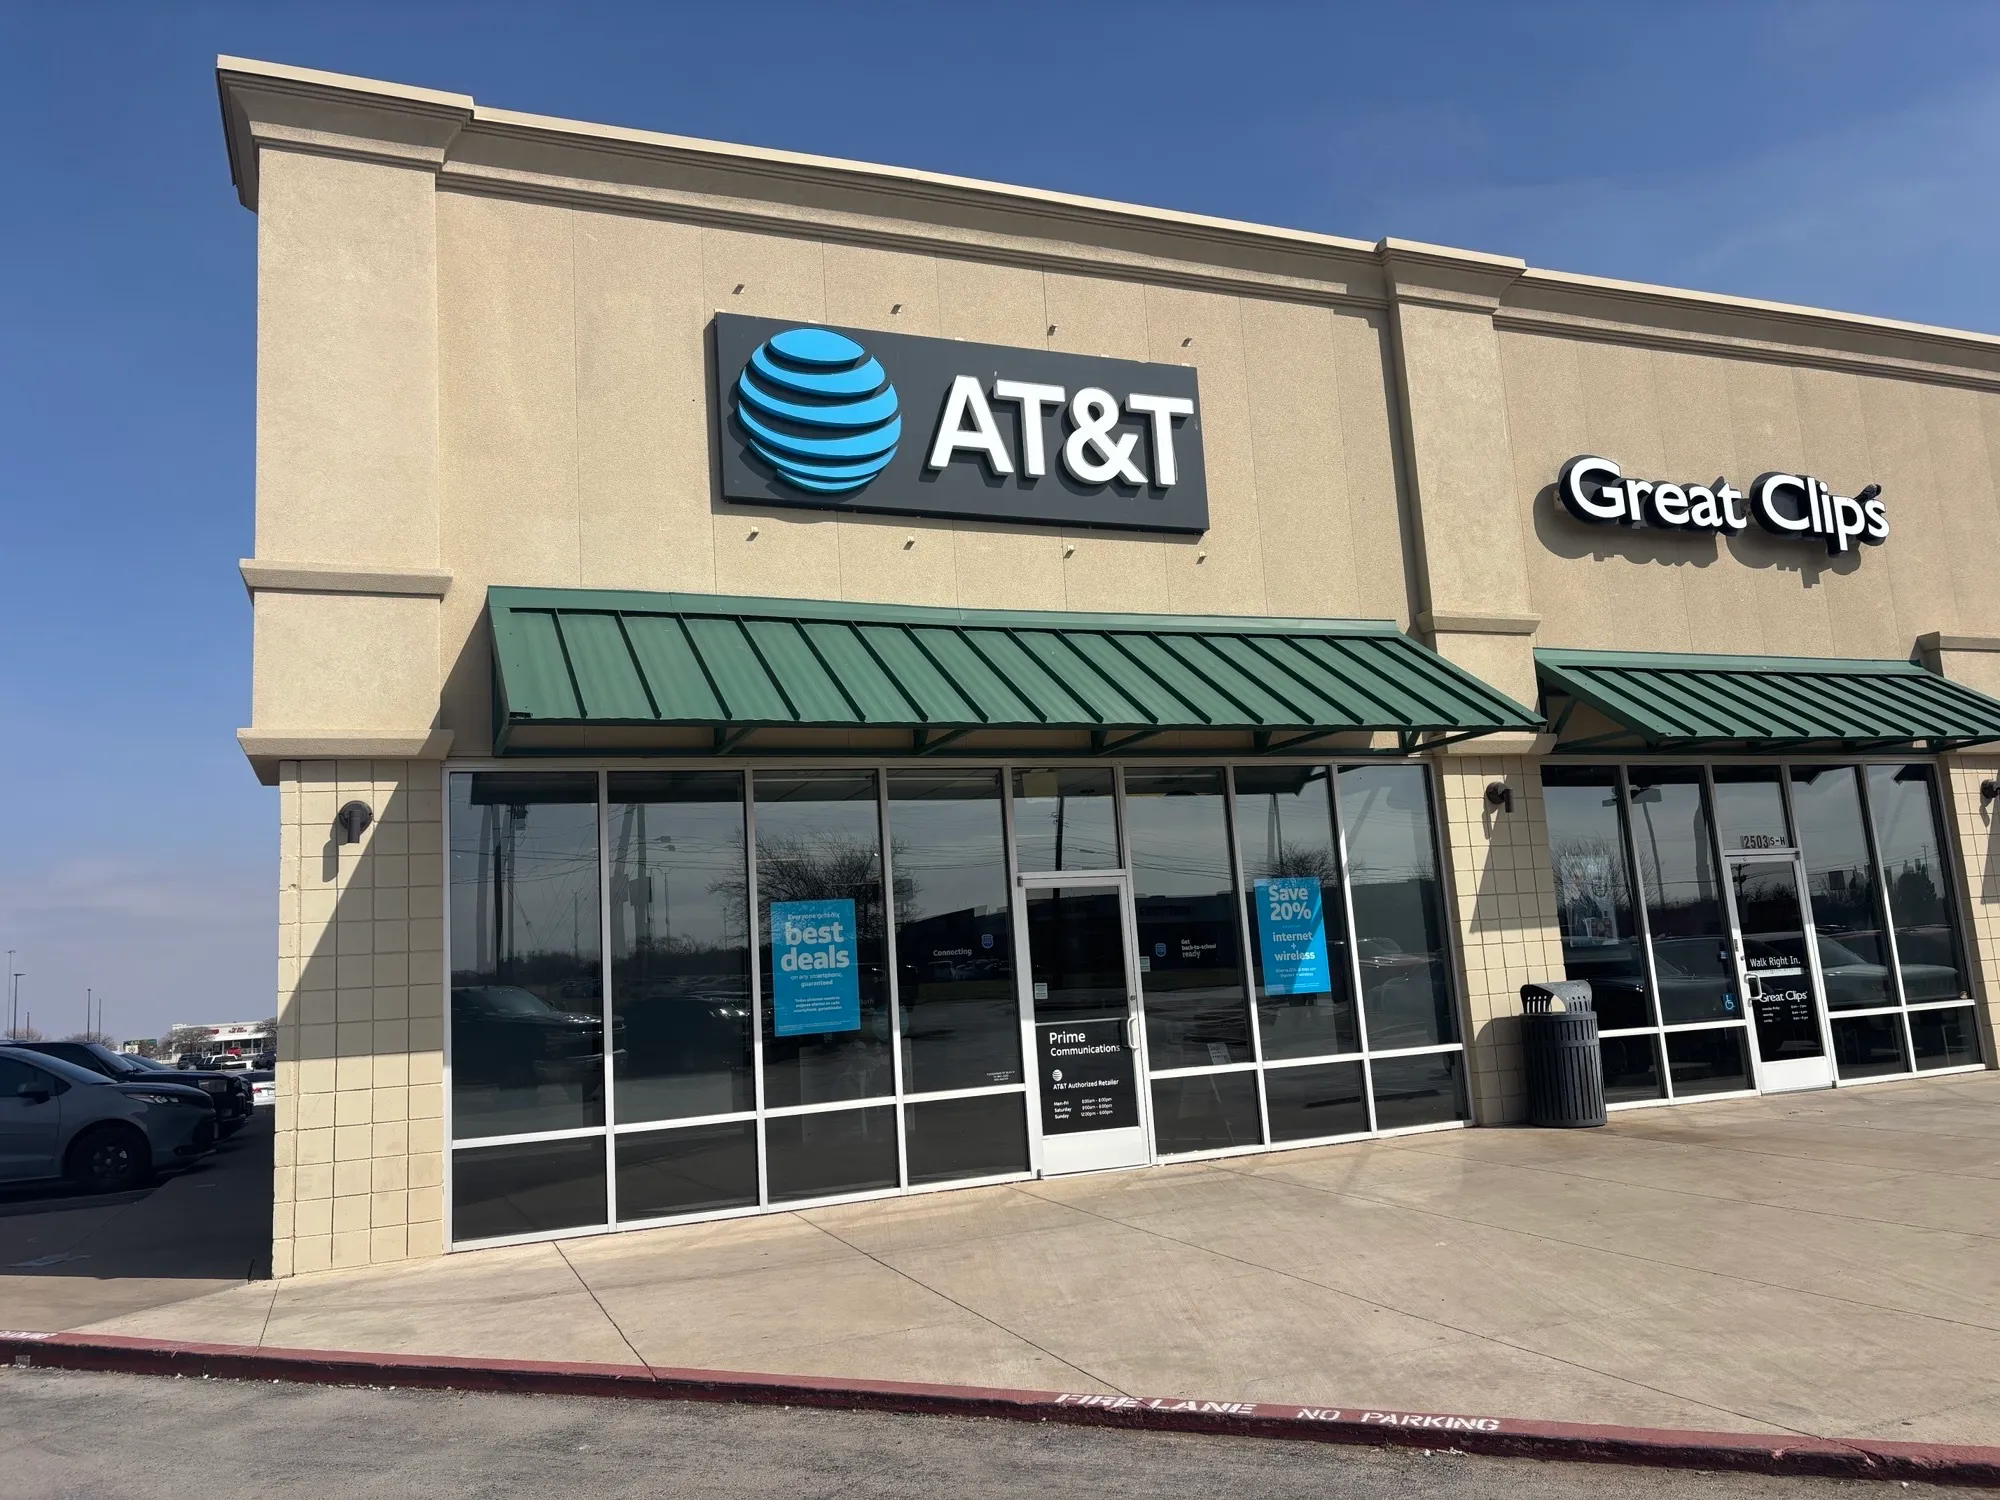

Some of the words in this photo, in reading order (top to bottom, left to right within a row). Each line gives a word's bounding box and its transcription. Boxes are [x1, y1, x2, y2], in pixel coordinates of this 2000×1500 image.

[927, 374, 1194, 488] AT&T
[1569, 456, 1747, 529] Great
[1761, 474, 1890, 551] Clips
[1744, 835, 1769, 849] 2503
[1268, 885, 1309, 902] Save
[1270, 902, 1312, 921] 20%
[785, 921, 844, 945] best
[1272, 931, 1314, 942] internet
[780, 944, 850, 972] deals
[933, 948, 972, 957] Connecting
[1183, 950, 1200, 959] ready
[1274, 950, 1316, 961] wireless
[1750, 957, 1767, 968] Walk
[1769, 956, 1788, 968] Right
[1789, 955, 1801, 965] In.
[1760, 992, 1785, 1003] Great
[1785, 990, 1807, 1003] Clips
[1049, 1030, 1086, 1045] Prime
[1050, 1043, 1121, 1057] Communications
[1068, 1081, 1098, 1089] Authorized
[1098, 1079, 1119, 1087] Retailer
[1053, 1393, 1144, 1409] FIRE
[1148, 1399, 1257, 1415] LANE
[1296, 1408, 1341, 1421] NO
[1360, 1412, 1500, 1431] PARKING
